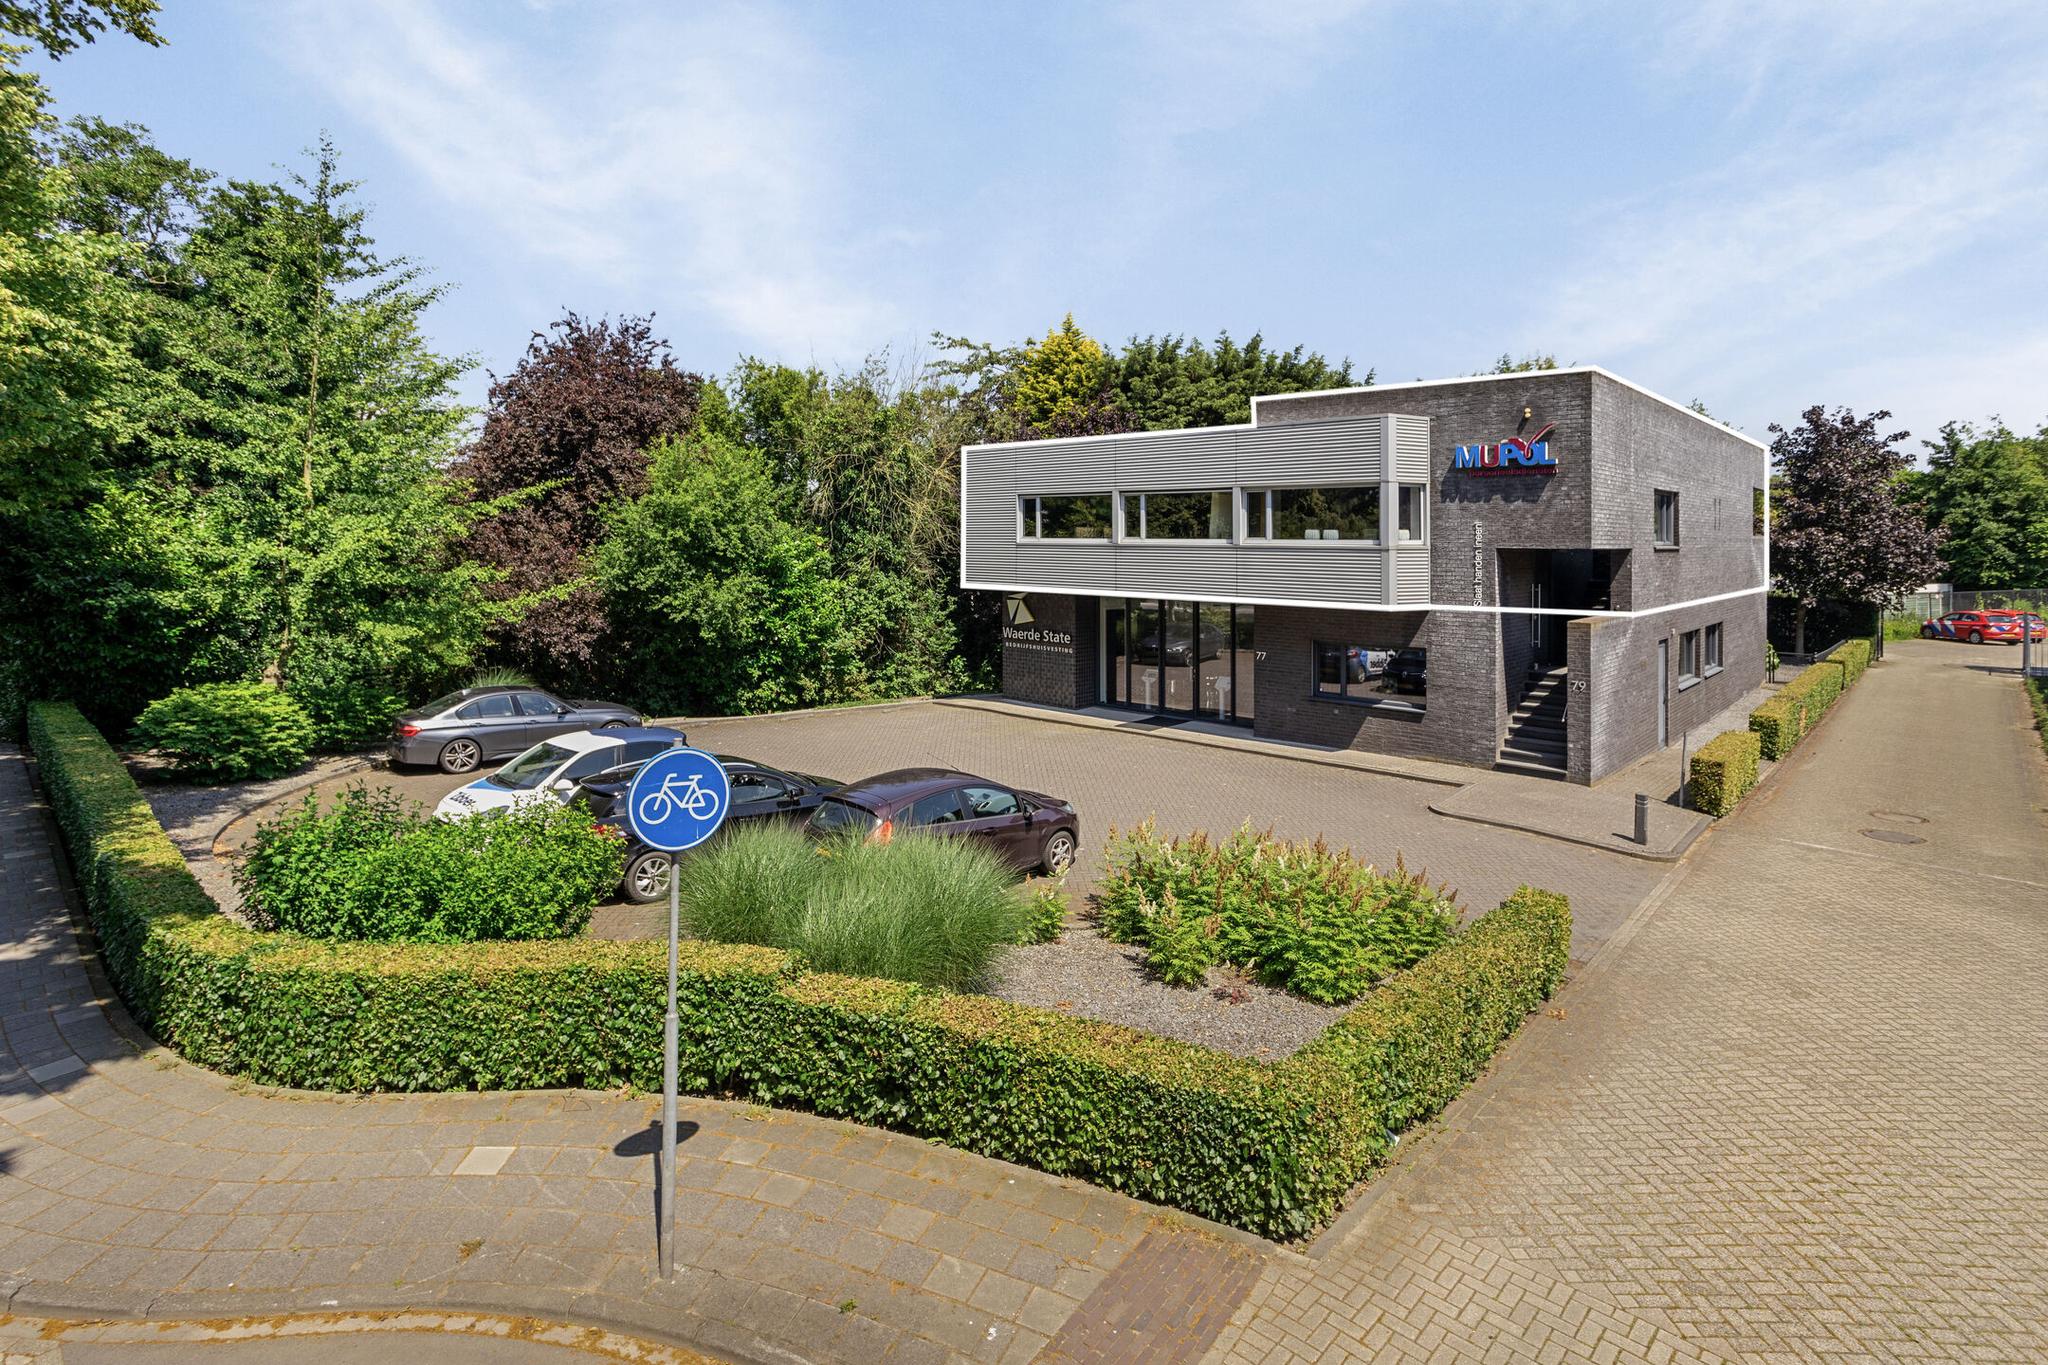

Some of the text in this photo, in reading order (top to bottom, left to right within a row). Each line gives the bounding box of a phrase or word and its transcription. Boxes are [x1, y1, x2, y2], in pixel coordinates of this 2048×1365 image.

[1455, 440, 1559, 469] MUPOL
[1474, 549, 1483, 583] handen
[1474, 584, 1483, 607] Slaat
[1002, 626, 1071, 643] Waerde State
[1255, 651, 1267, 660] 77
[1571, 680, 1586, 691] 79
